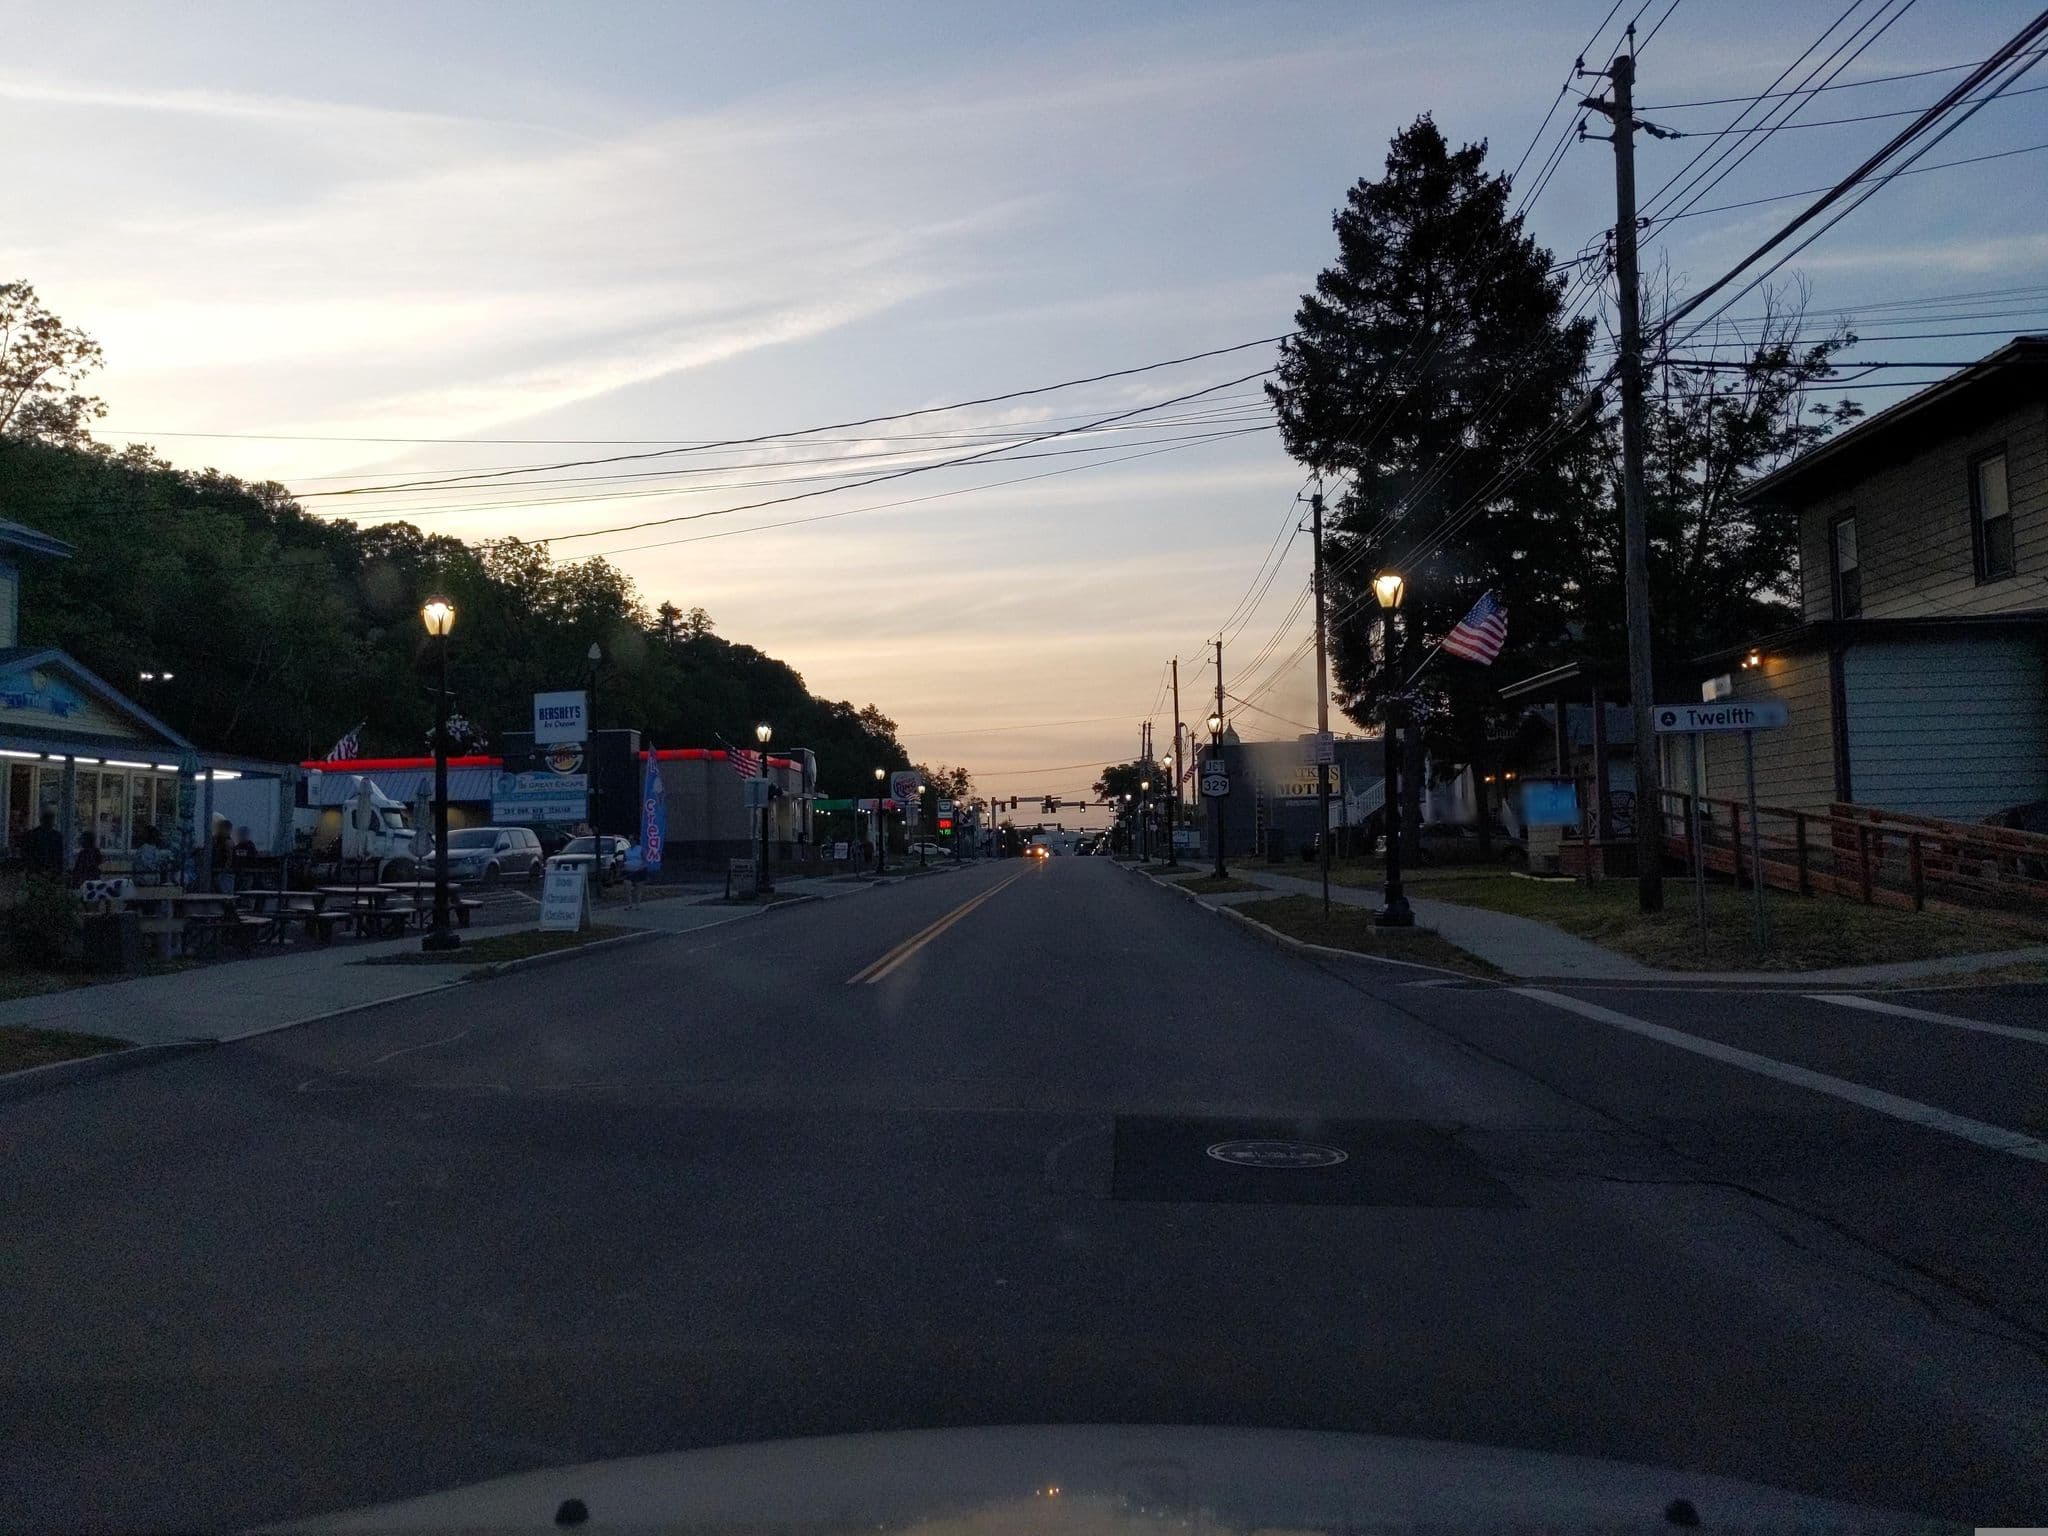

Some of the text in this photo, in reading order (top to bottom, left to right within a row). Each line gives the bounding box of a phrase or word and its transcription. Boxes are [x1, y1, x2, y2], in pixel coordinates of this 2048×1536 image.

[539, 705, 581, 720] HERSHEY'S
[1687, 708, 1754, 726] Twelfth
[1207, 761, 1225, 771] JCT
[1204, 780, 1228, 791] 329
